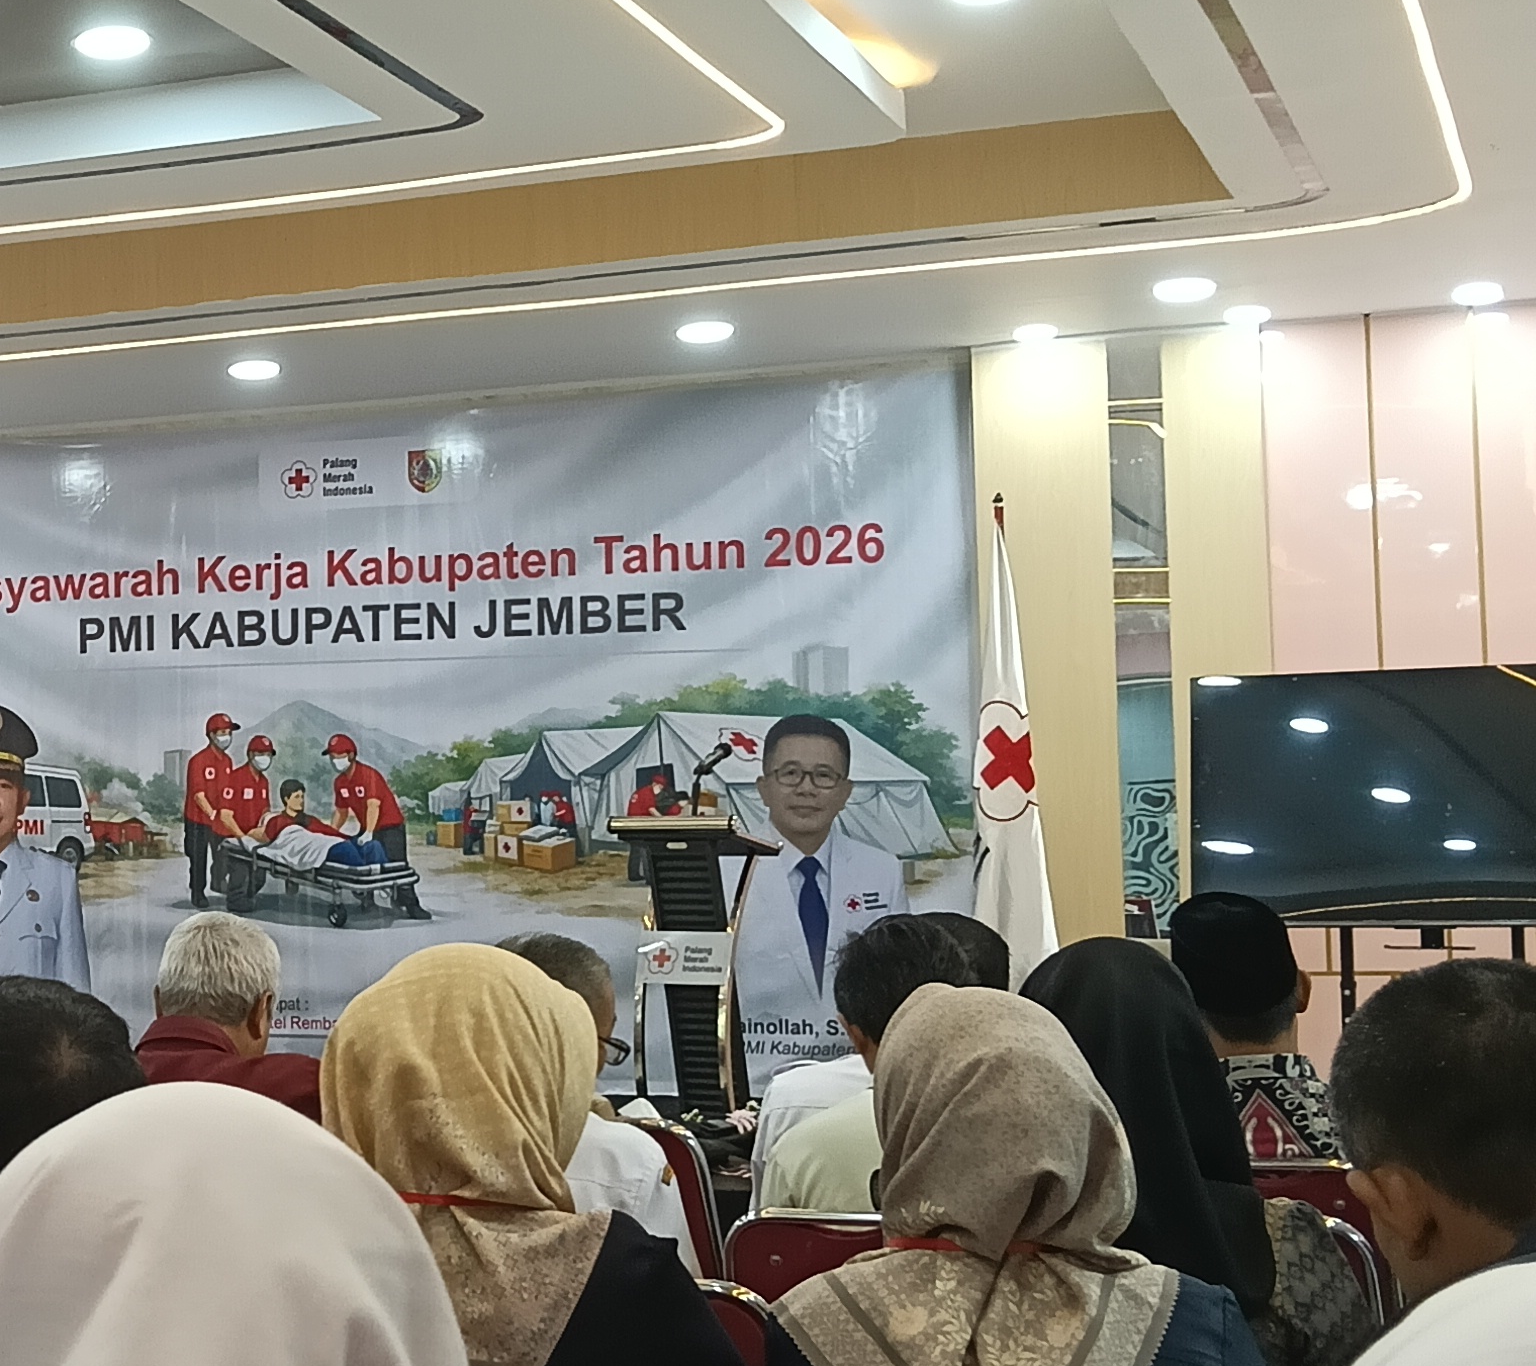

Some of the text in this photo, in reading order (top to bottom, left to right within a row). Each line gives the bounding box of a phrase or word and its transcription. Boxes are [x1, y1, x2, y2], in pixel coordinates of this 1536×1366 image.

[322, 457, 358, 469] Palang
[322, 471, 355, 483] Merah
[322, 483, 374, 497] Indonesia
[197, 552, 309, 601] Kerja
[326, 545, 576, 592] Kabupaten
[593, 533, 745, 575] Tahun
[763, 522, 885, 569] 2026
[79, 591, 687, 655] PMI KABUPATEN JEMBER
[276, 996, 301, 1014] pat
